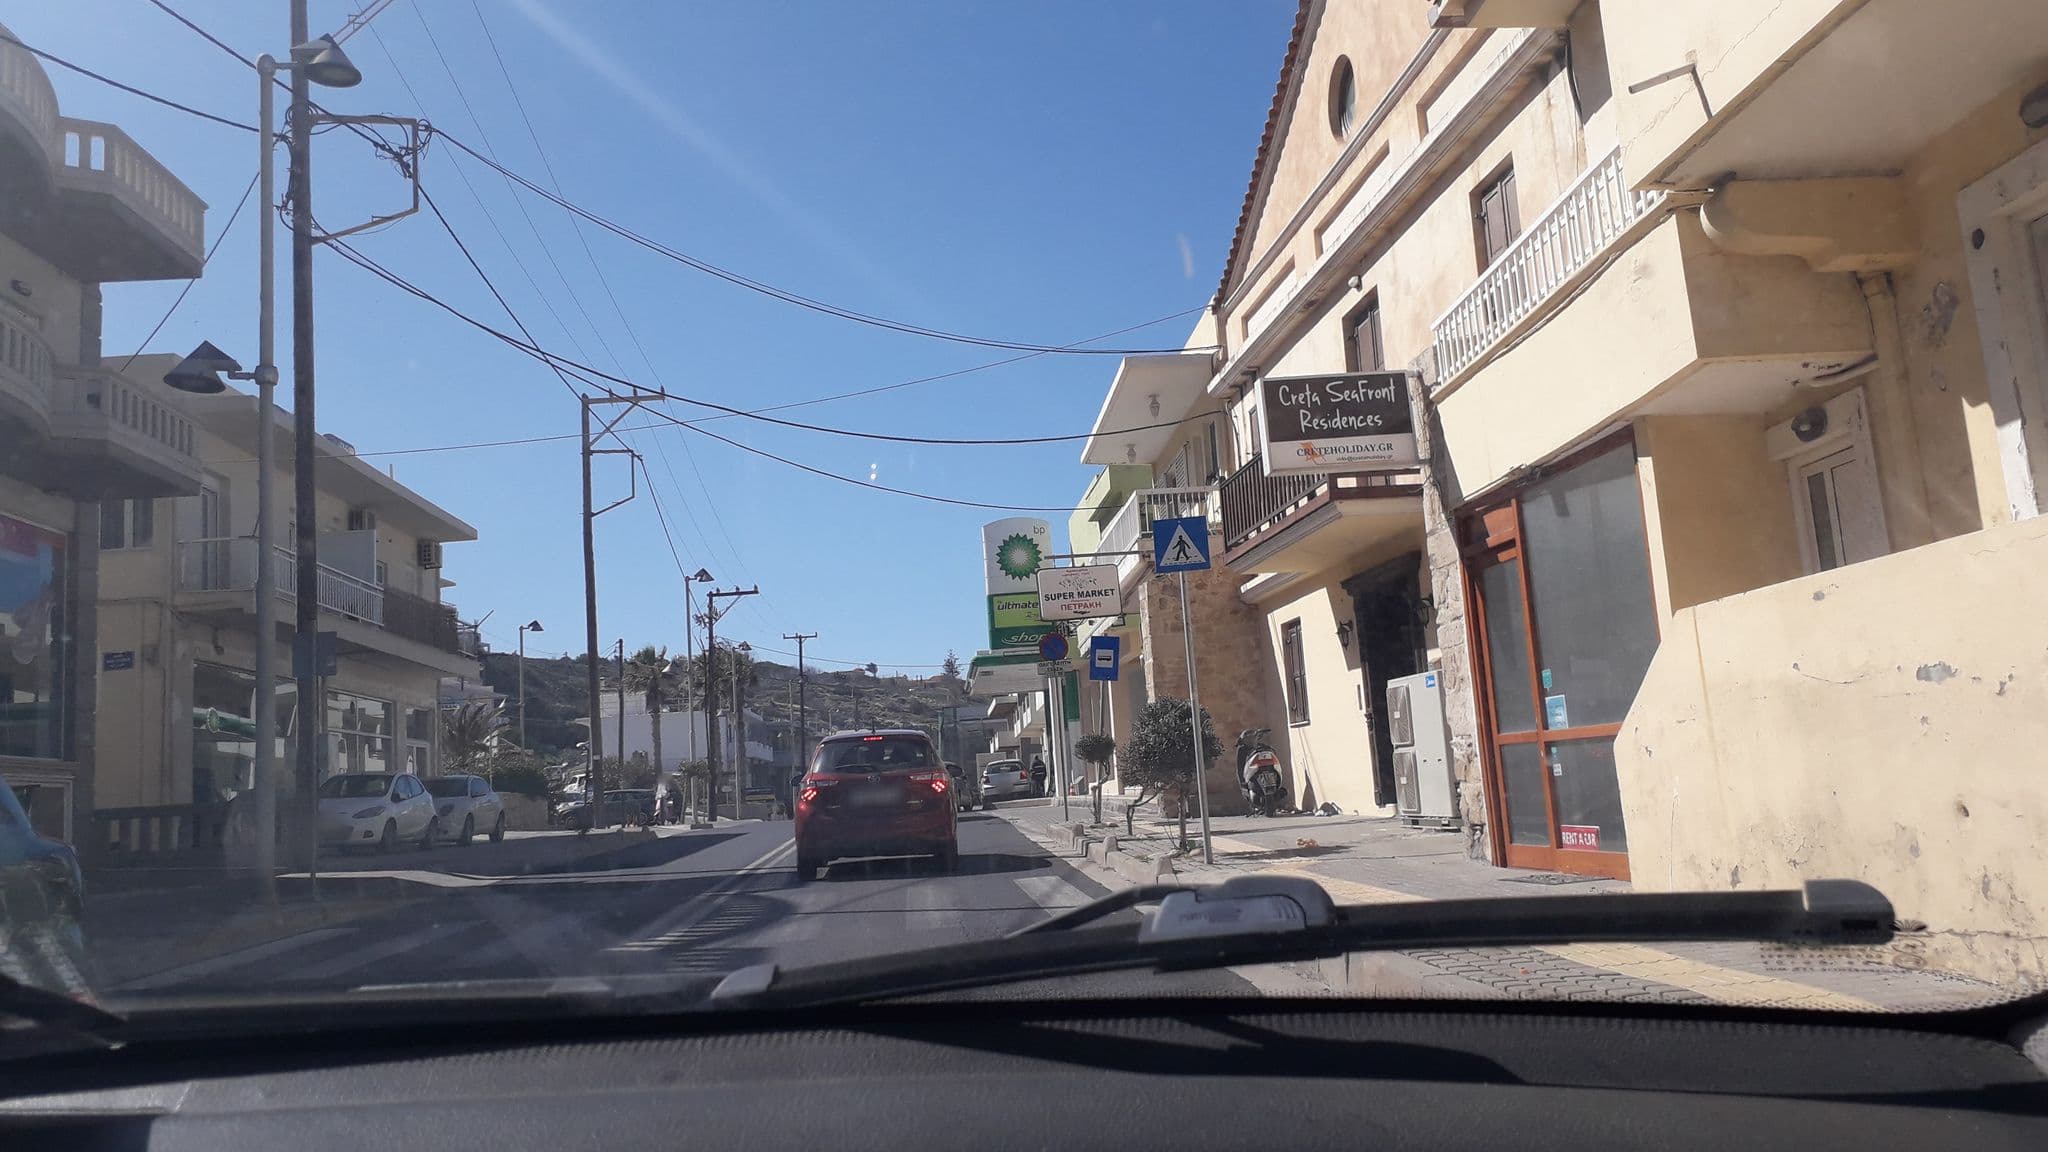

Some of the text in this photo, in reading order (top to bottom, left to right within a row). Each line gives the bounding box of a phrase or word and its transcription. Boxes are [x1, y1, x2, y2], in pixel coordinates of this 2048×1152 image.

[1279, 378, 1396, 408] Creta SeaFront
[1299, 407, 1383, 433] Residences
[1033, 525, 1046, 535] bp
[1044, 589, 1115, 602] SUPER MARKET
[1060, 601, 1102, 612] ΠΕΤΡΑΚΗ
[1562, 832, 1577, 846] RENT
[1579, 832, 1585, 846] A
